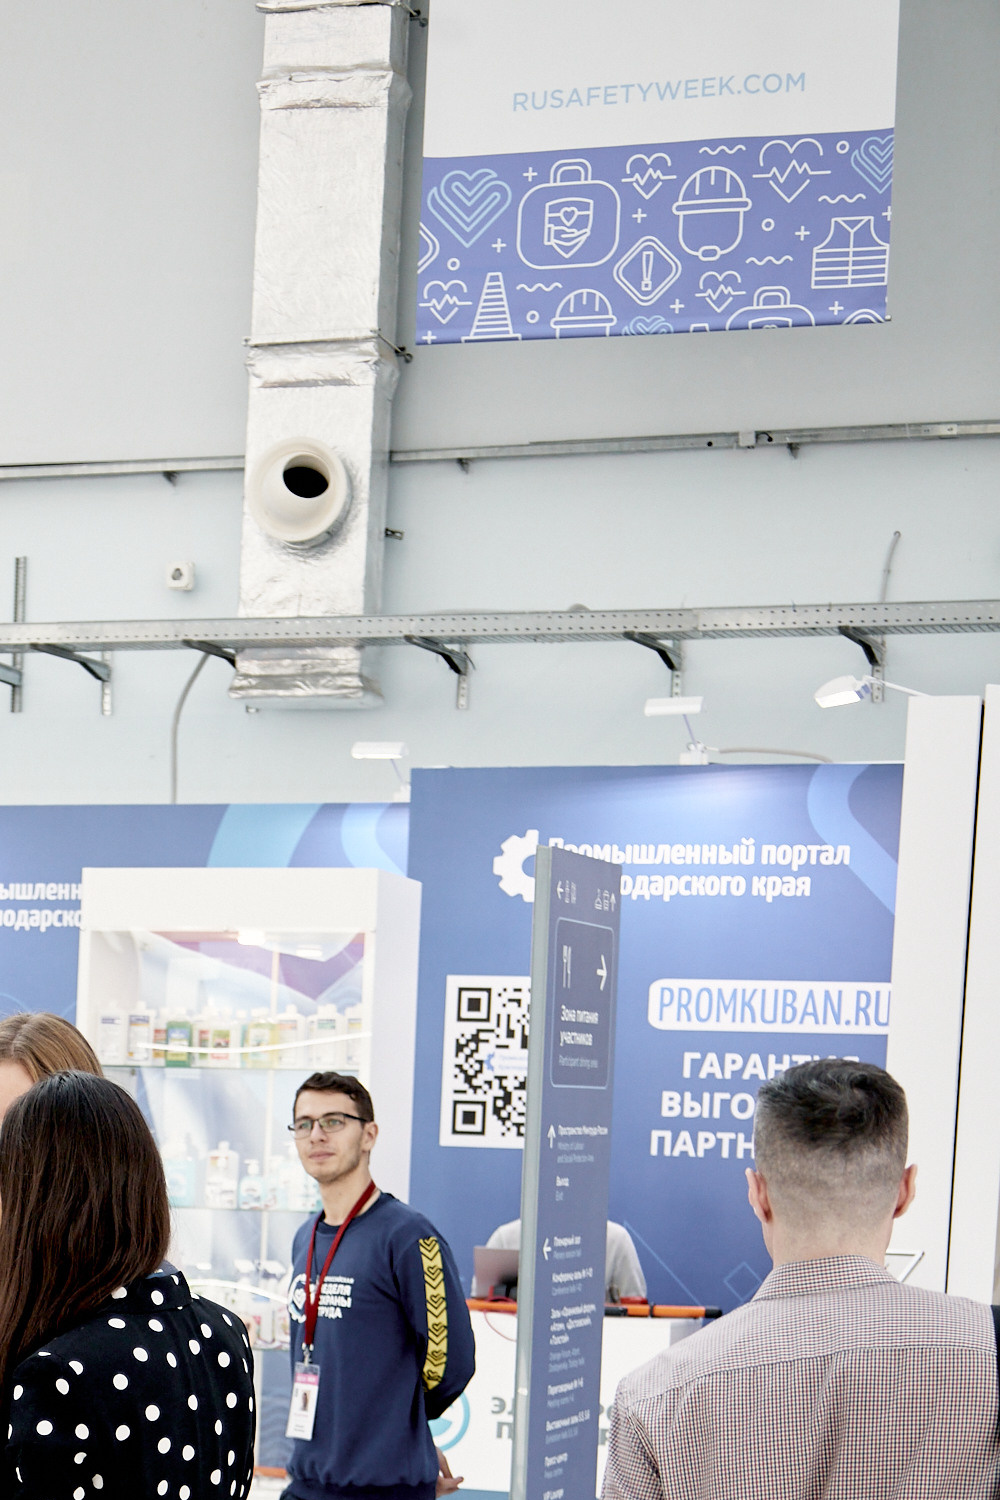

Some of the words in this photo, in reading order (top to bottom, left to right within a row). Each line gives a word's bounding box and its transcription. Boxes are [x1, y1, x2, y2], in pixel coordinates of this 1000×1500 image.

[512, 72, 806, 112] RUSAFETYWEEK.COM
[760, 844, 850, 871] портал
[752, 876, 811, 902] края
[659, 986, 891, 1027] PROMKUBAN.RU
[682, 1051, 860, 1080] ГАРАН
